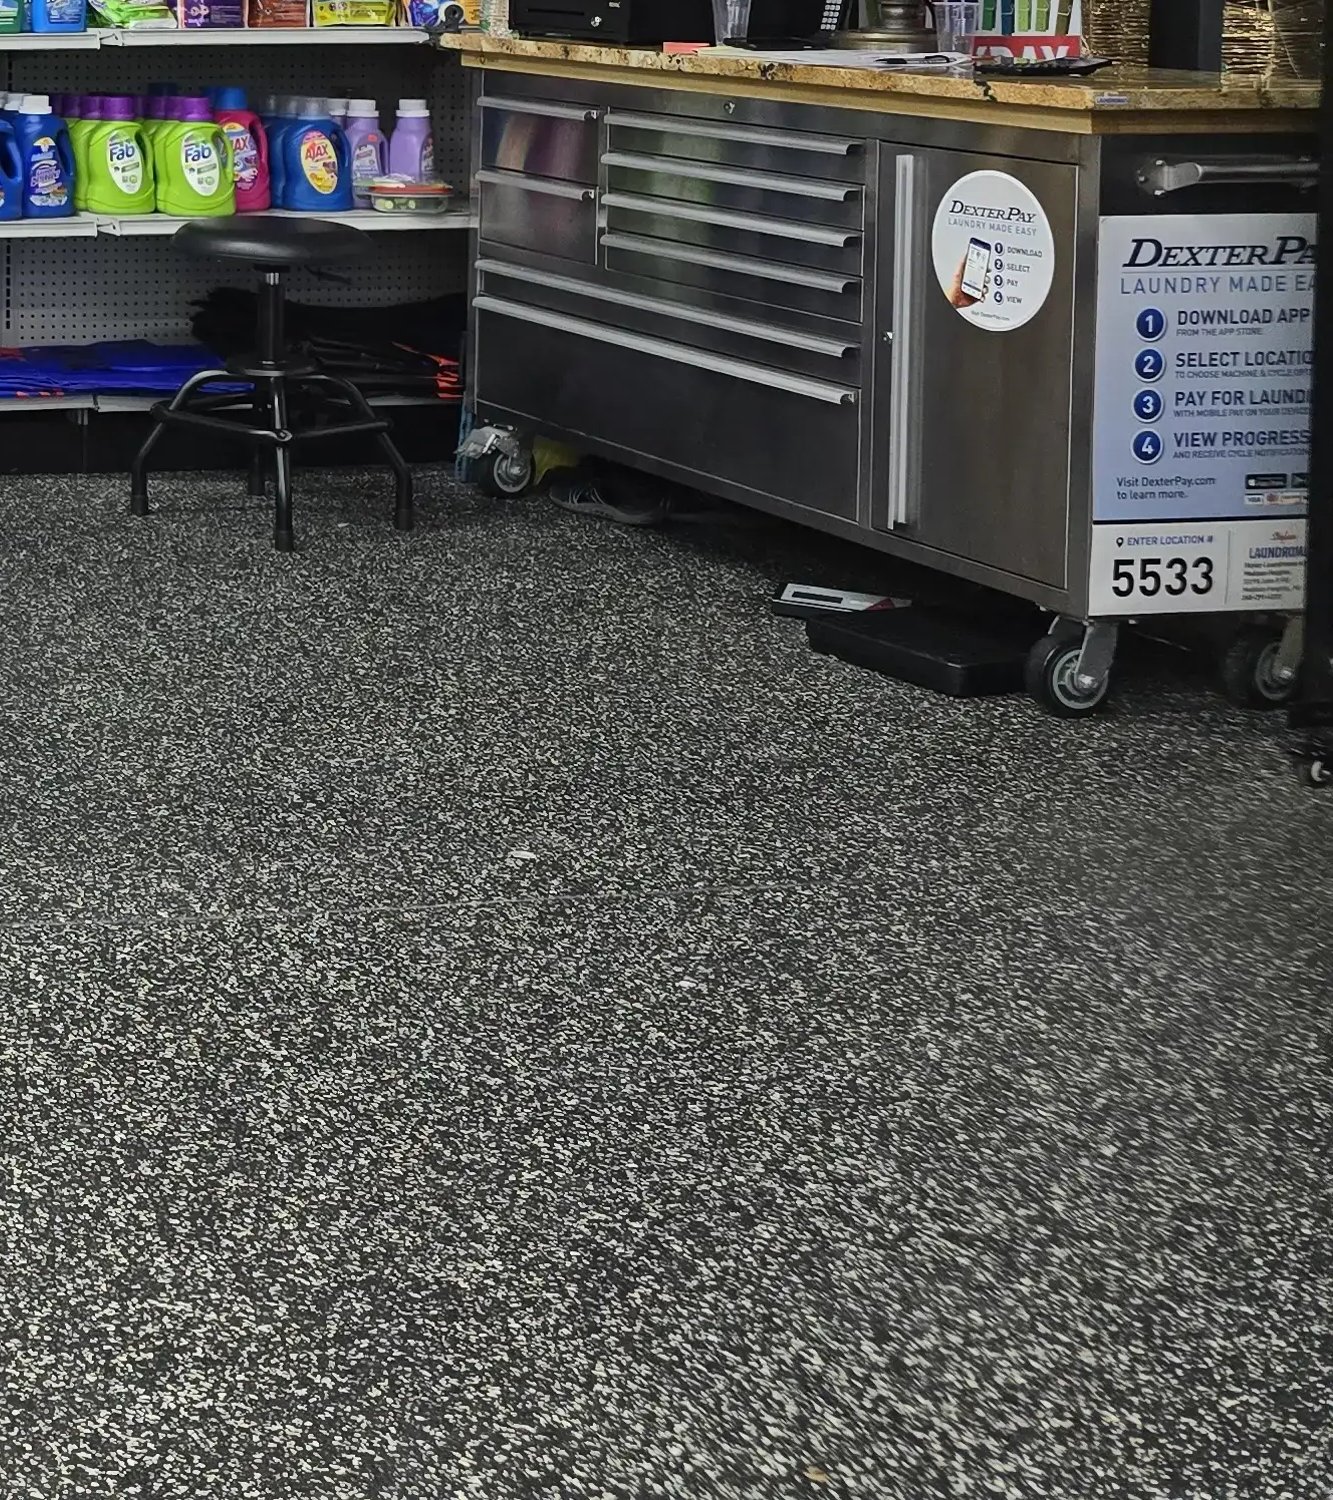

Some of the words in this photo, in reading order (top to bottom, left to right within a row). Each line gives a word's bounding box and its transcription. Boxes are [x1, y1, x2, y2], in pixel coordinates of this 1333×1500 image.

[109, 144, 136, 162] Fab
[185, 144, 212, 163] Fab
[304, 144, 329, 161] AJAX
[948, 218, 986, 230] LAUNDRY
[989, 223, 1012, 234] MADE
[1015, 226, 1037, 236] EASY
[1007, 246, 1043, 258] DOWNLOAD
[1122, 236, 1316, 269] DEXTERPA
[1007, 263, 1030, 273] SELECT
[1007, 278, 1018, 287] PAY
[1120, 276, 1220, 295] LAUNDRY
[1229, 275, 1291, 293] MADE
[1007, 296, 1022, 304] VIEW
[1177, 309, 1273, 326] DOWNLOAD
[1277, 308, 1310, 324] APP
[1176, 352, 1240, 367] SELECT
[1243, 350, 1313, 366] LOCATIO
[1175, 392, 1203, 406] PAY
[1212, 391, 1244, 406] FOR
[1197, 409, 1227, 417] MOBILE
[1174, 433, 1217, 447] VIEW
[1222, 430, 1311, 446] PROGRESS
[1173, 451, 1190, 459] AND
[1192, 450, 1226, 458] RECEIVE
[1117, 477, 1139, 487] Visit
[1142, 476, 1216, 487] DexterPay.com
[1117, 491, 1127, 499] to
[1130, 490, 1156, 499] learn
[1158, 490, 1188, 499] more.
[1127, 537, 1157, 546] ENTER
[1160, 536, 1205, 545] LOCATION
[1112, 556, 1214, 597] 5533
